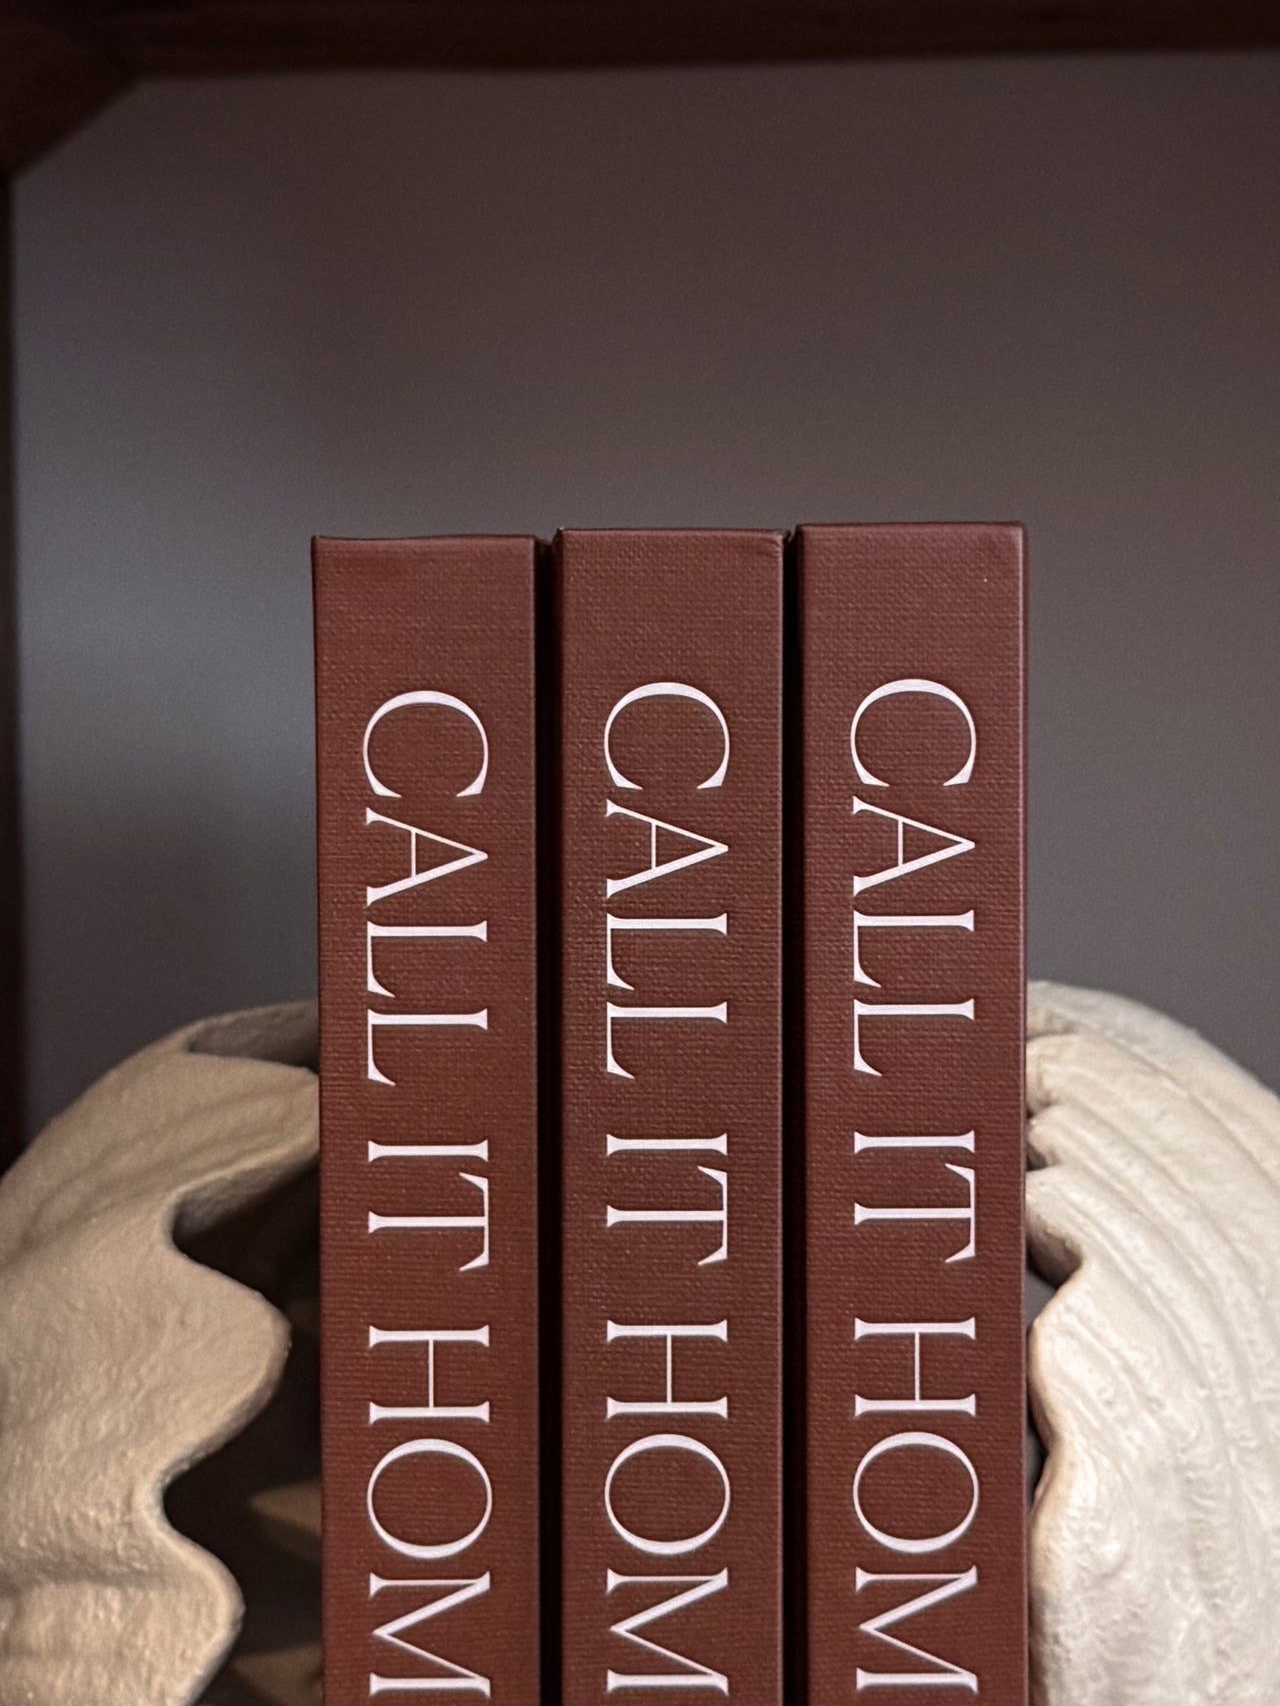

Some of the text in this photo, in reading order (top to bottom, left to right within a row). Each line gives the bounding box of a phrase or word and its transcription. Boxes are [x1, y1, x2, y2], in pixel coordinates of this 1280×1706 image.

[360, 689, 490, 1088] CALL
[602, 680, 731, 1081] CALL
[848, 677, 978, 1078] CALL
[366, 1138, 491, 1273] IT
[604, 1131, 729, 1268] IT
[852, 1128, 977, 1265] IT
